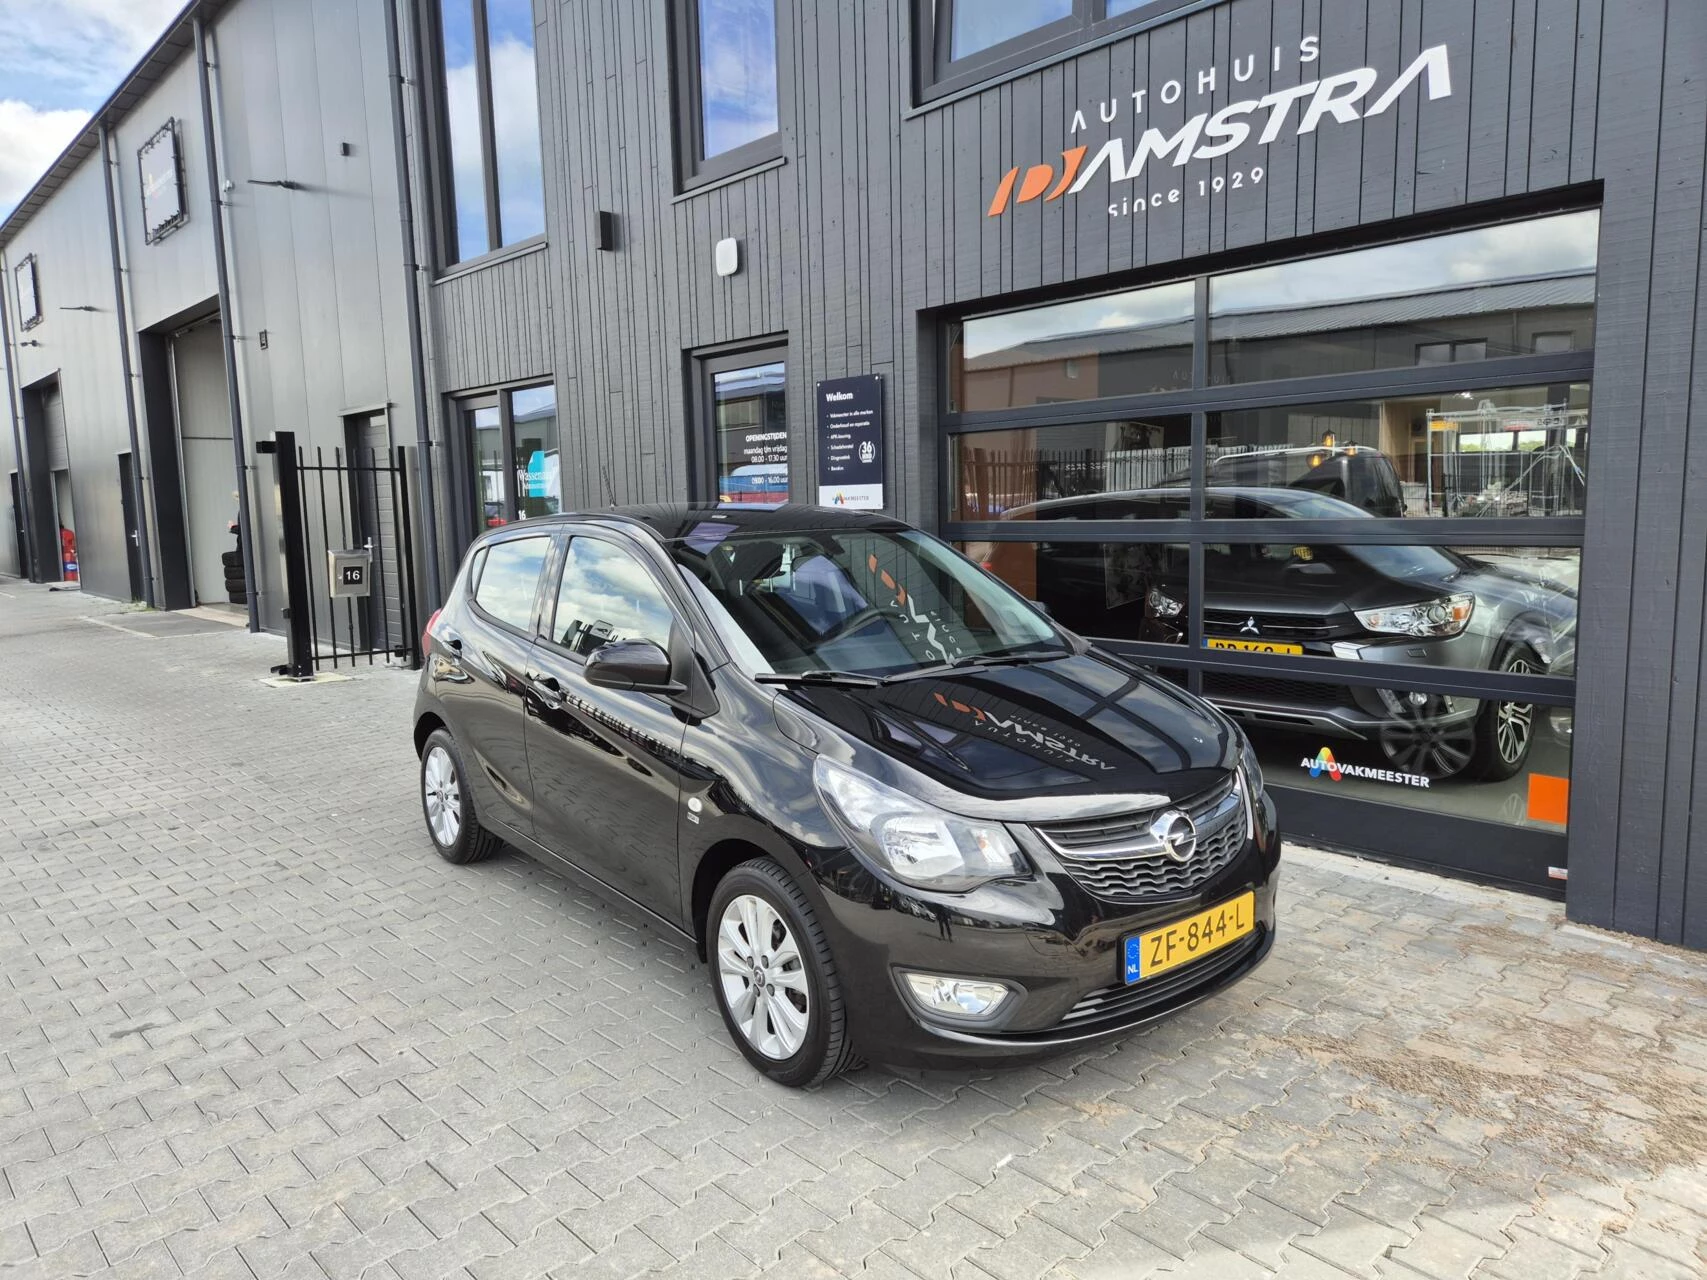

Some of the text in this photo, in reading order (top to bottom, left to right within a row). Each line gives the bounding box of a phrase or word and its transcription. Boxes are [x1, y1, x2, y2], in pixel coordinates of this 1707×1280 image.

[1070, 35, 1320, 133] AUTOHUIS
[1108, 166, 1264, 217] since 1929
[826, 391, 854, 402] Welkom
[745, 431, 787, 442] OPENINGSTIJDEN
[743, 446, 764, 455] maandag
[772, 445, 788, 453] vrijdag
[861, 440, 873, 454] 36
[518, 510, 526, 520] 16
[345, 570, 360, 580] 16
[1300, 757, 1430, 788] AUTOVAKMEESTER
[1150, 903, 1245, 968] ZF-844-L
[1127, 963, 1139, 975] NL
